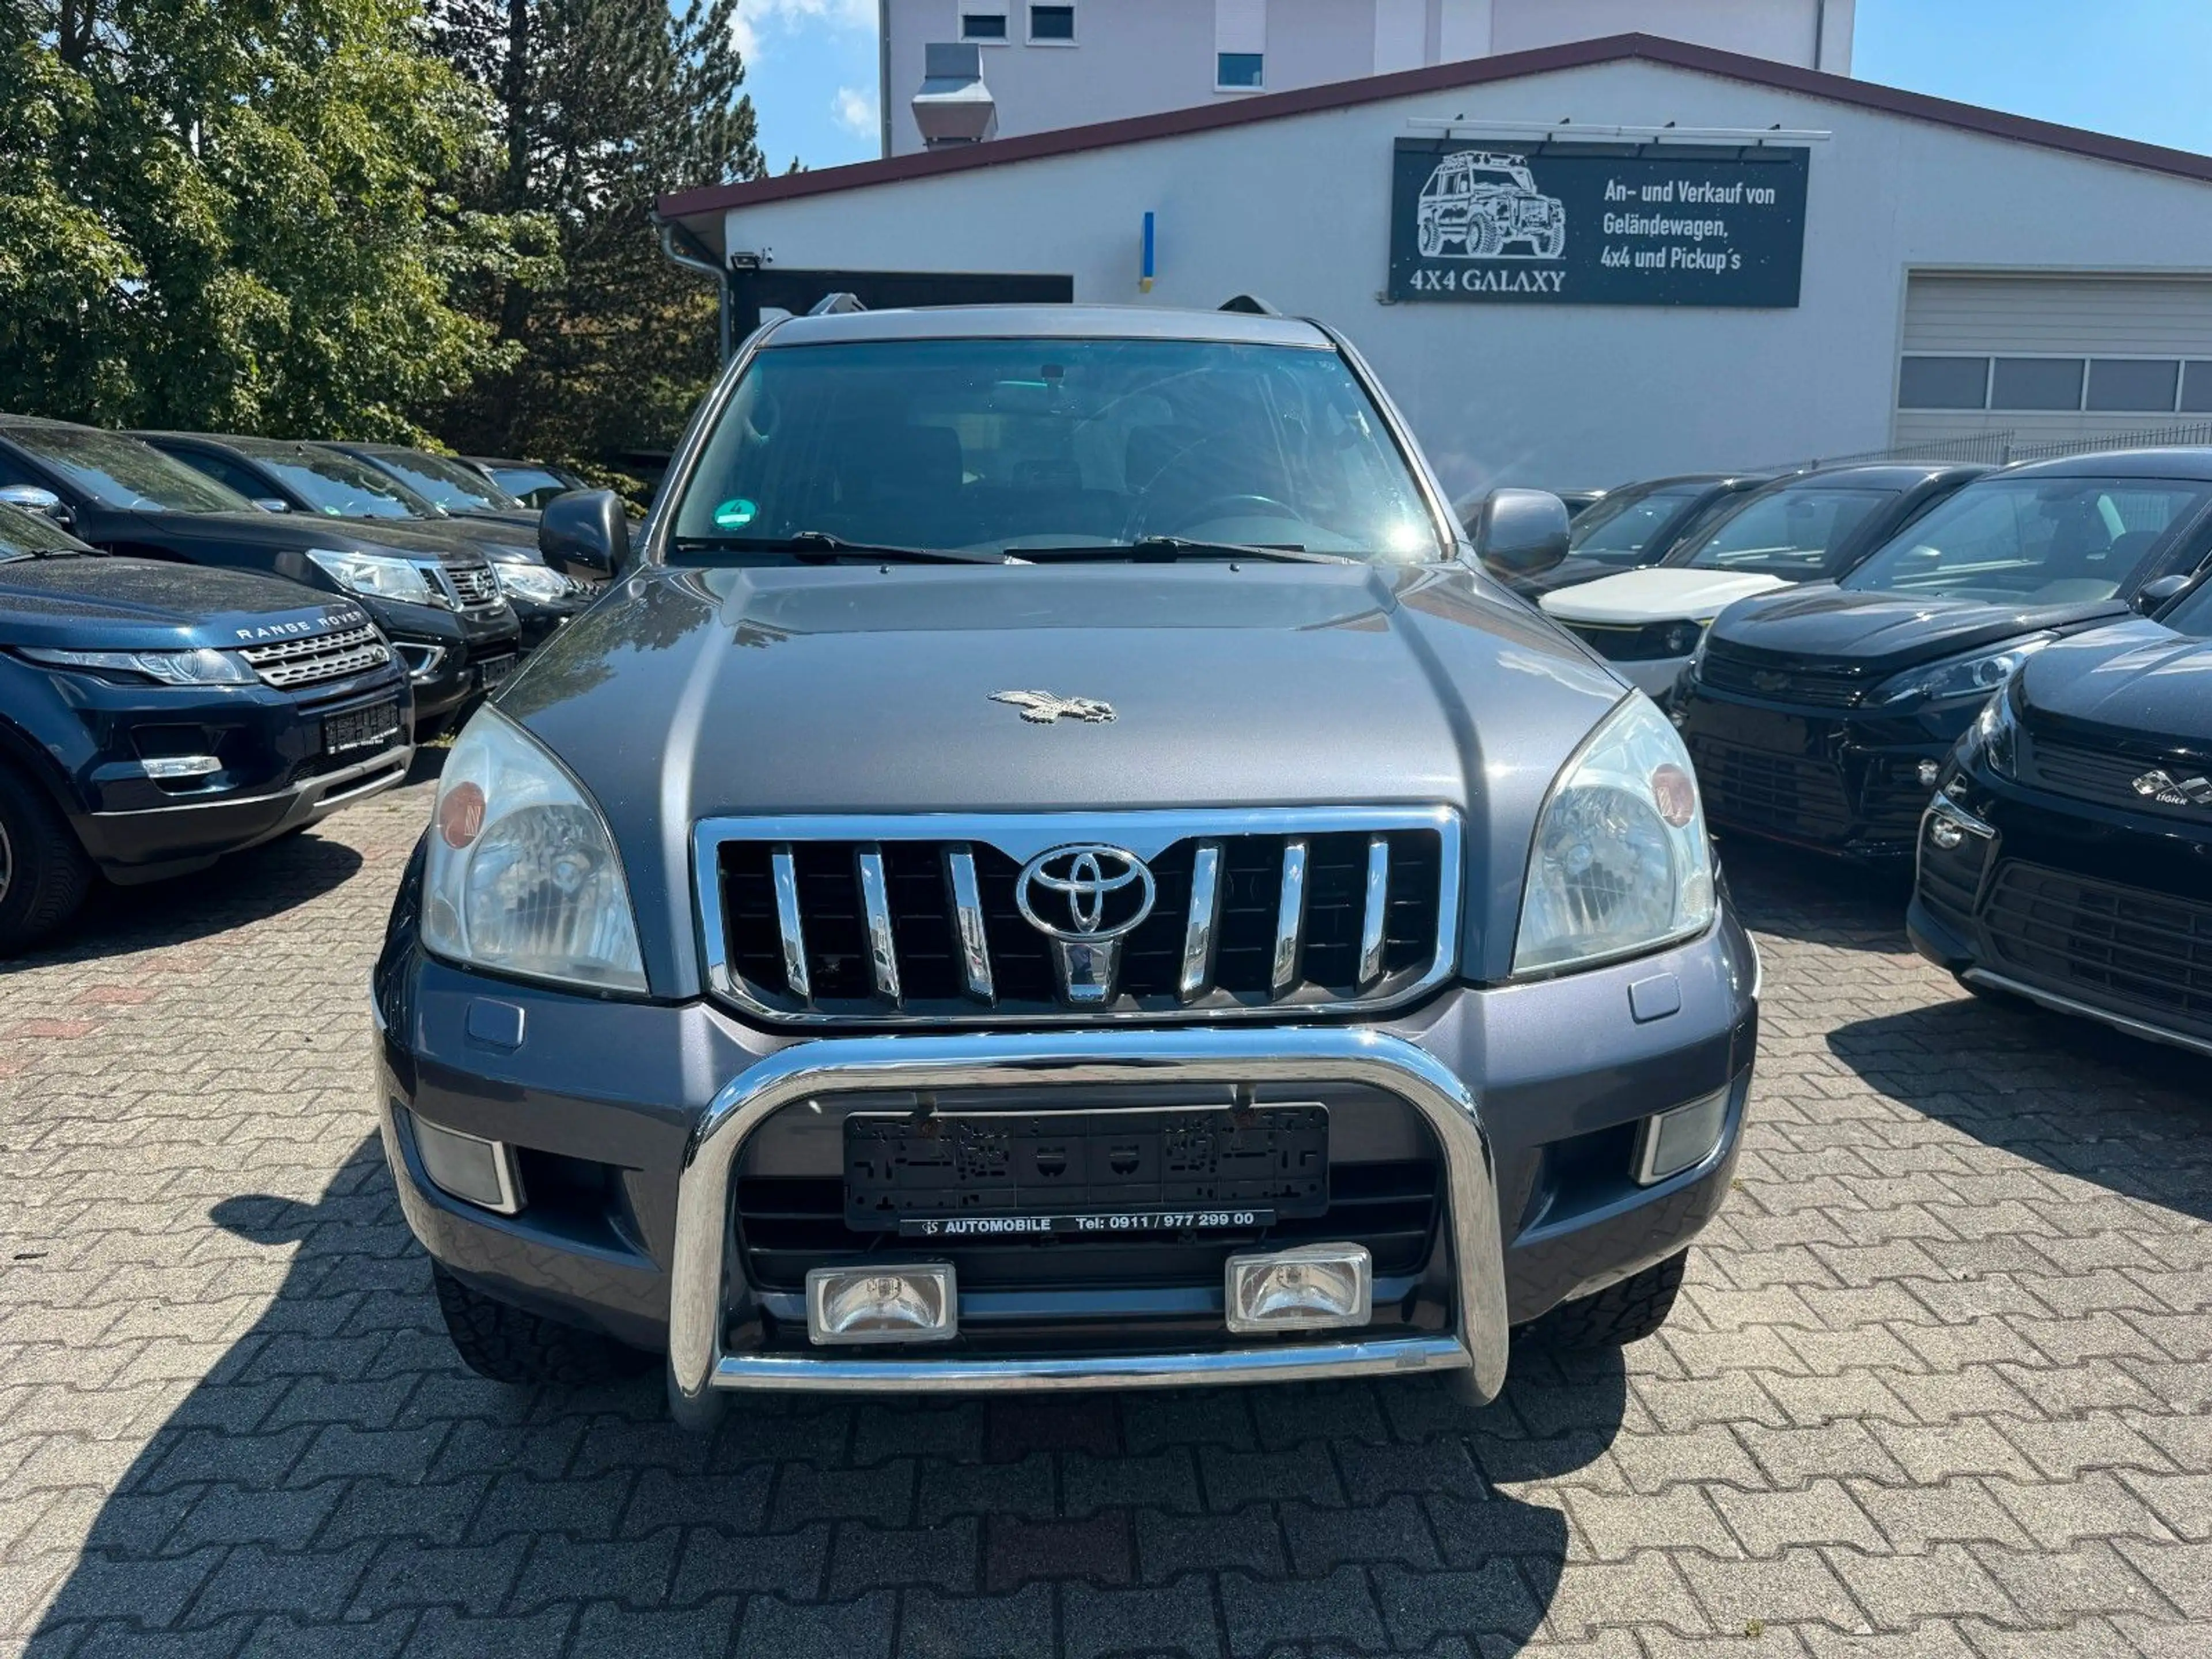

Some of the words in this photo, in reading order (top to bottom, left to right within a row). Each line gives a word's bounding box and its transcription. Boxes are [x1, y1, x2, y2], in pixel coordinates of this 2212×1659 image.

[1604, 179, 1637, 201] An-
[1642, 180, 1673, 202] und
[1678, 181, 1743, 203] Verkauf
[1746, 187, 1775, 204] von
[1603, 212, 1729, 241] Geländewagen,
[1601, 245, 1630, 267] 4x4
[1635, 247, 1666, 268] und
[1410, 269, 1456, 291] 4X4
[1461, 268, 1566, 292] GALAXY
[236, 621, 310, 639] RANGE
[317, 611, 362, 627] ROVER
[945, 1219, 1051, 1233] AUTOMOBILE
[1075, 1218, 1104, 1229] Tel:
[1110, 1216, 1148, 1229] 0911
[1154, 1214, 1160, 1228] /
[1164, 1215, 1194, 1227] 977
[1198, 1214, 1229, 1226] 299
[1233, 1213, 1254, 1225] 00
